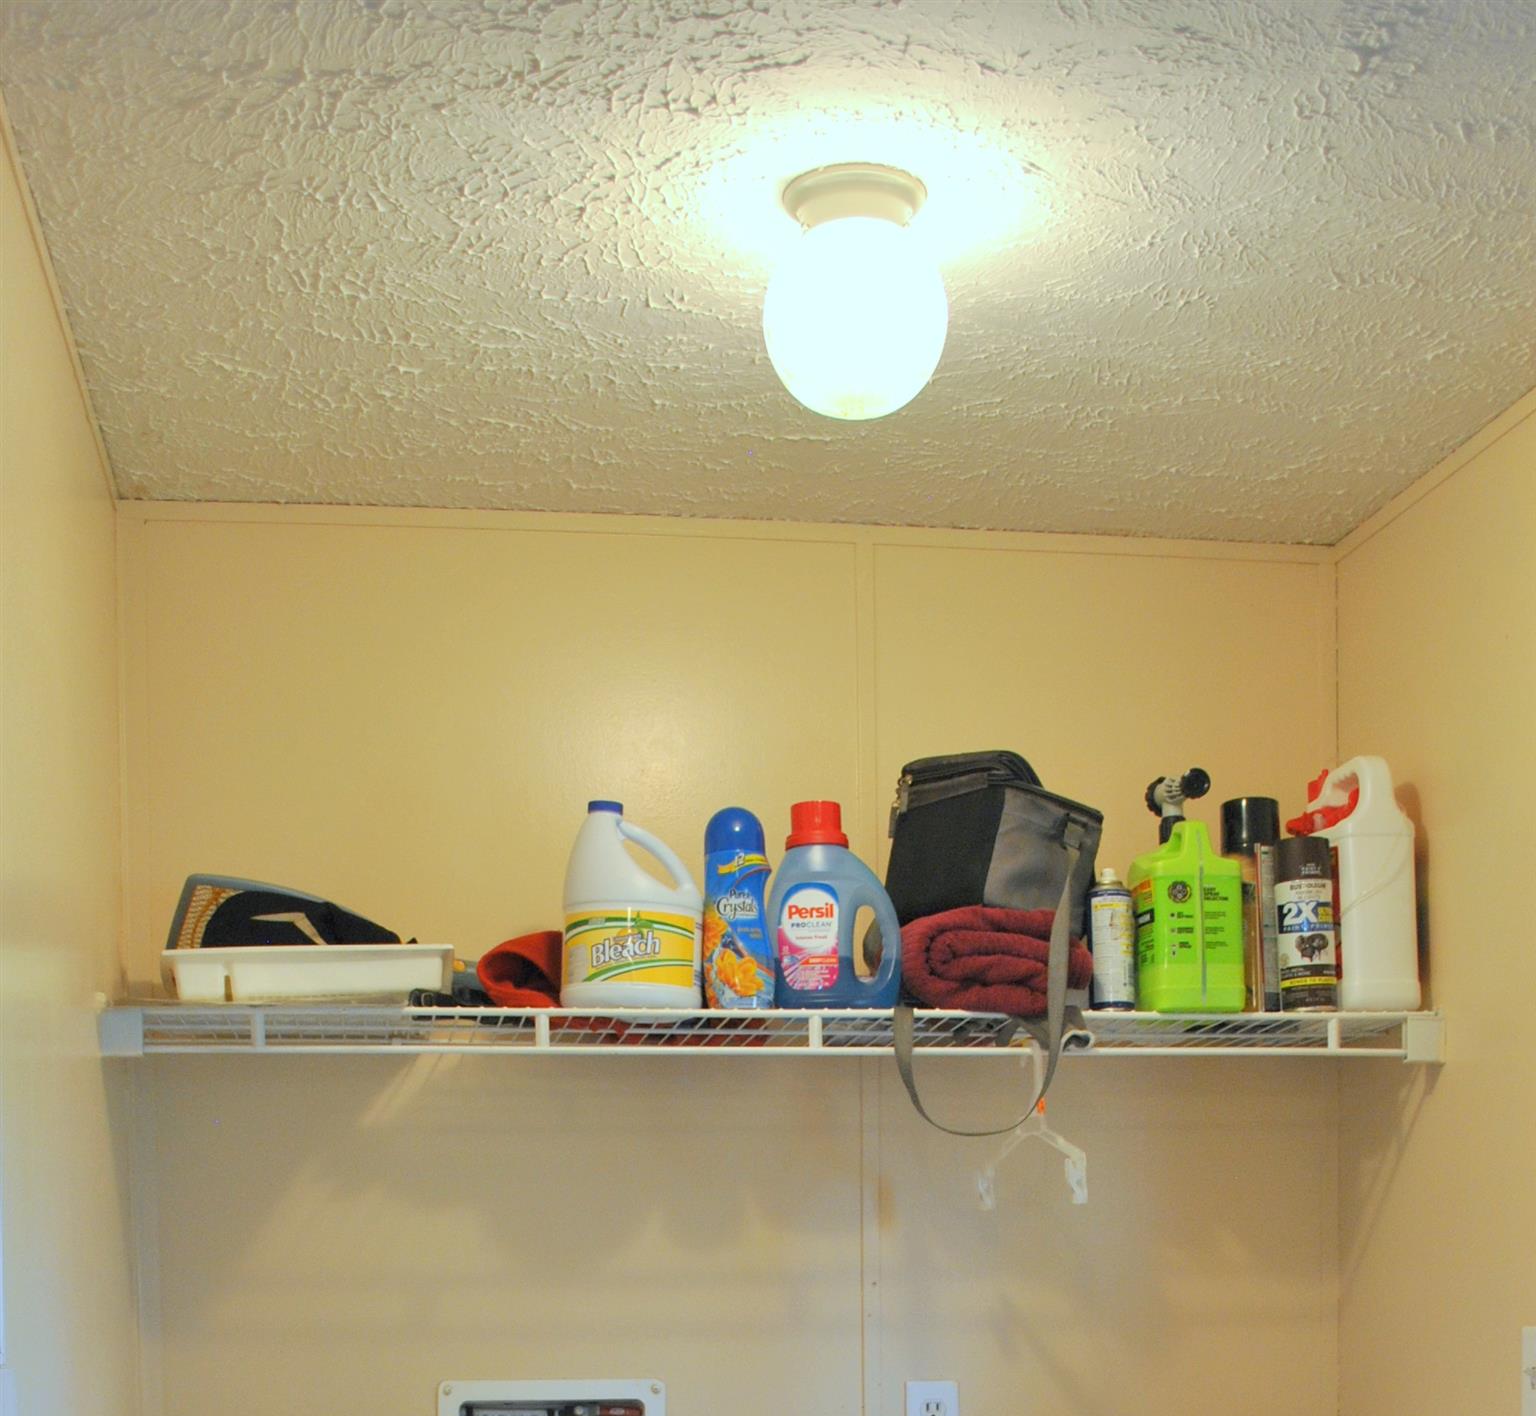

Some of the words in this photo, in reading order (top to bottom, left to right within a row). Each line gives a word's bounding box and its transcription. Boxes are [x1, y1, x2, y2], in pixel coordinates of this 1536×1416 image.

[716, 896, 758, 919] Crystals
[788, 902, 834, 920] Persil
[1282, 900, 1318, 926] 2X
[591, 930, 661, 967] Bleach
